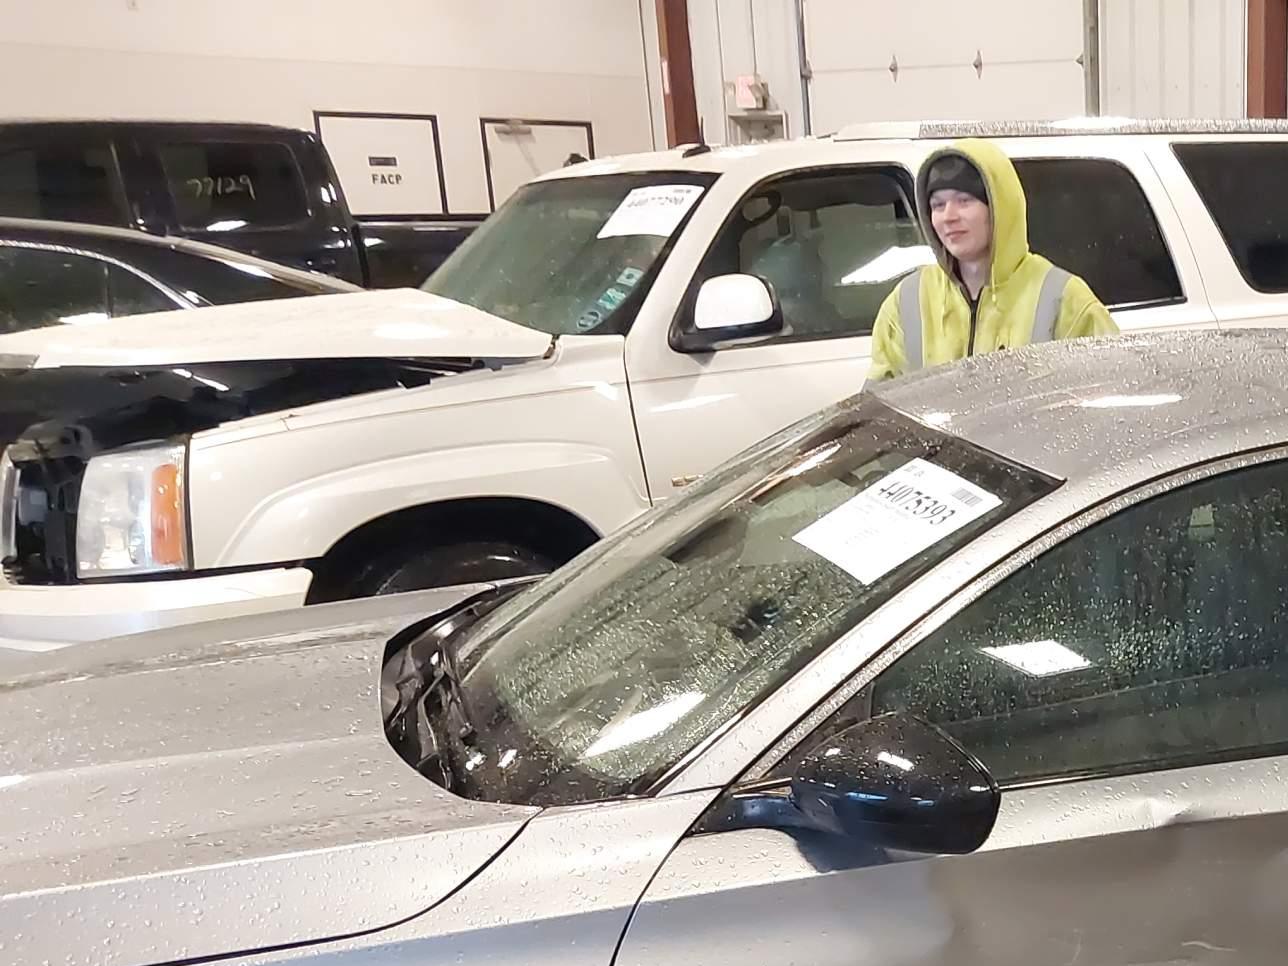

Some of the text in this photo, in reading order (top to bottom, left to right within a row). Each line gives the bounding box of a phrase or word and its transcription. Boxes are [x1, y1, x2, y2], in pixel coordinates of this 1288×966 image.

[186, 174, 256, 201] 77129
[371, 173, 402, 185] FACP
[878, 481, 956, 526] 44075393
